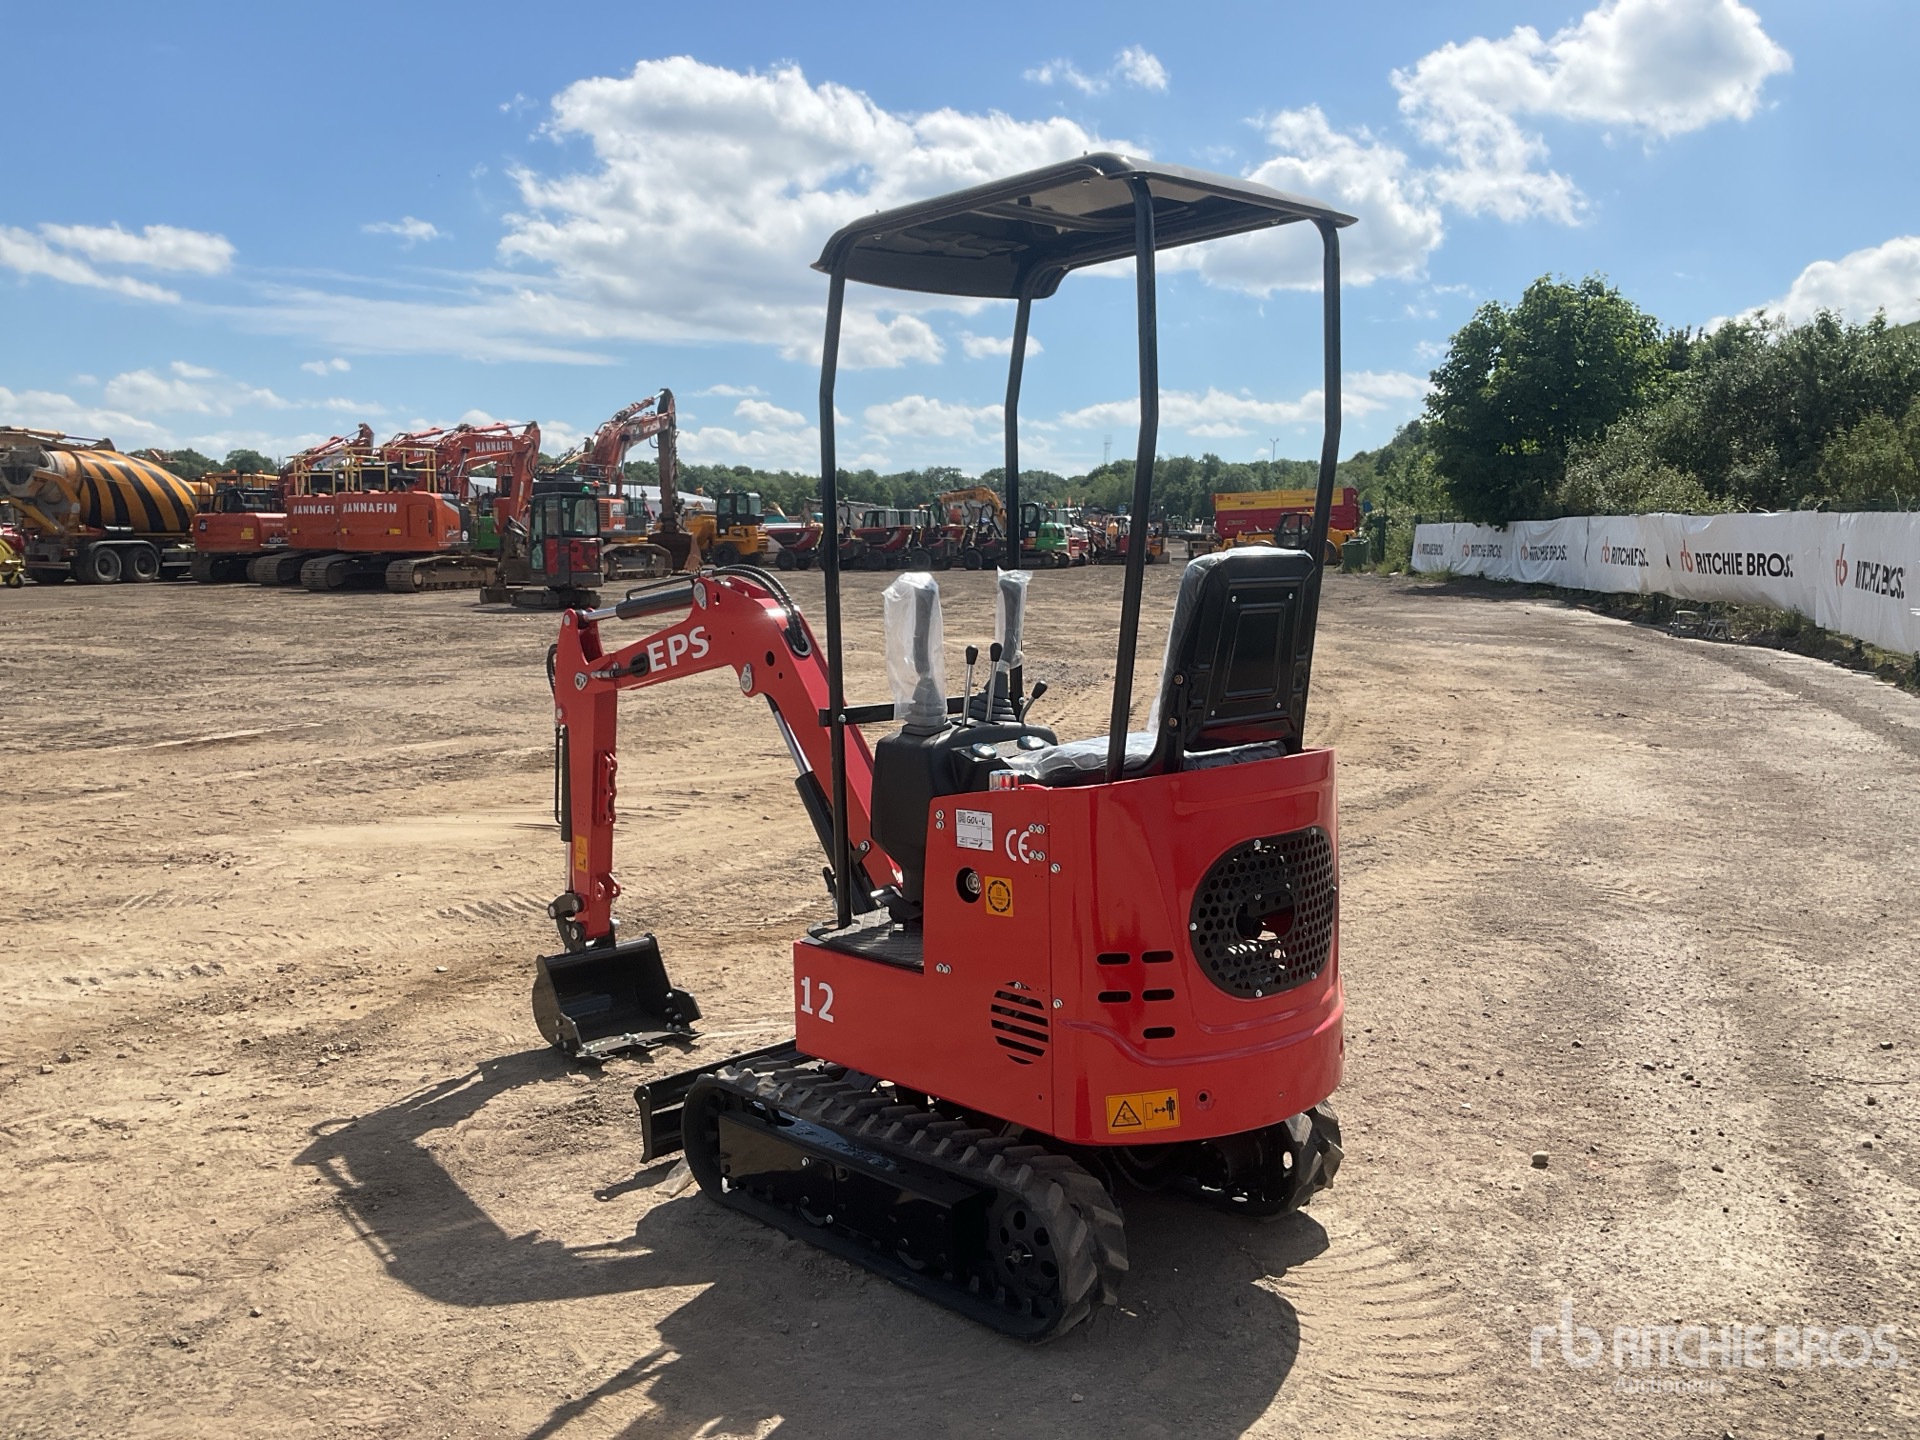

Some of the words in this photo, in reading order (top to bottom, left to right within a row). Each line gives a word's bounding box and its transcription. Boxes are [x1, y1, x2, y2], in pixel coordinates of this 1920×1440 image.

[475, 441, 513, 452] HANNAFIN
[293, 505, 335, 515] HANNAFI
[343, 503, 397, 513] HANNAFIN
[1695, 552, 1743, 576] RITCHIE
[1746, 553, 1793, 578] BROS.
[646, 625, 710, 673] EPS
[800, 976, 835, 1023] 12
